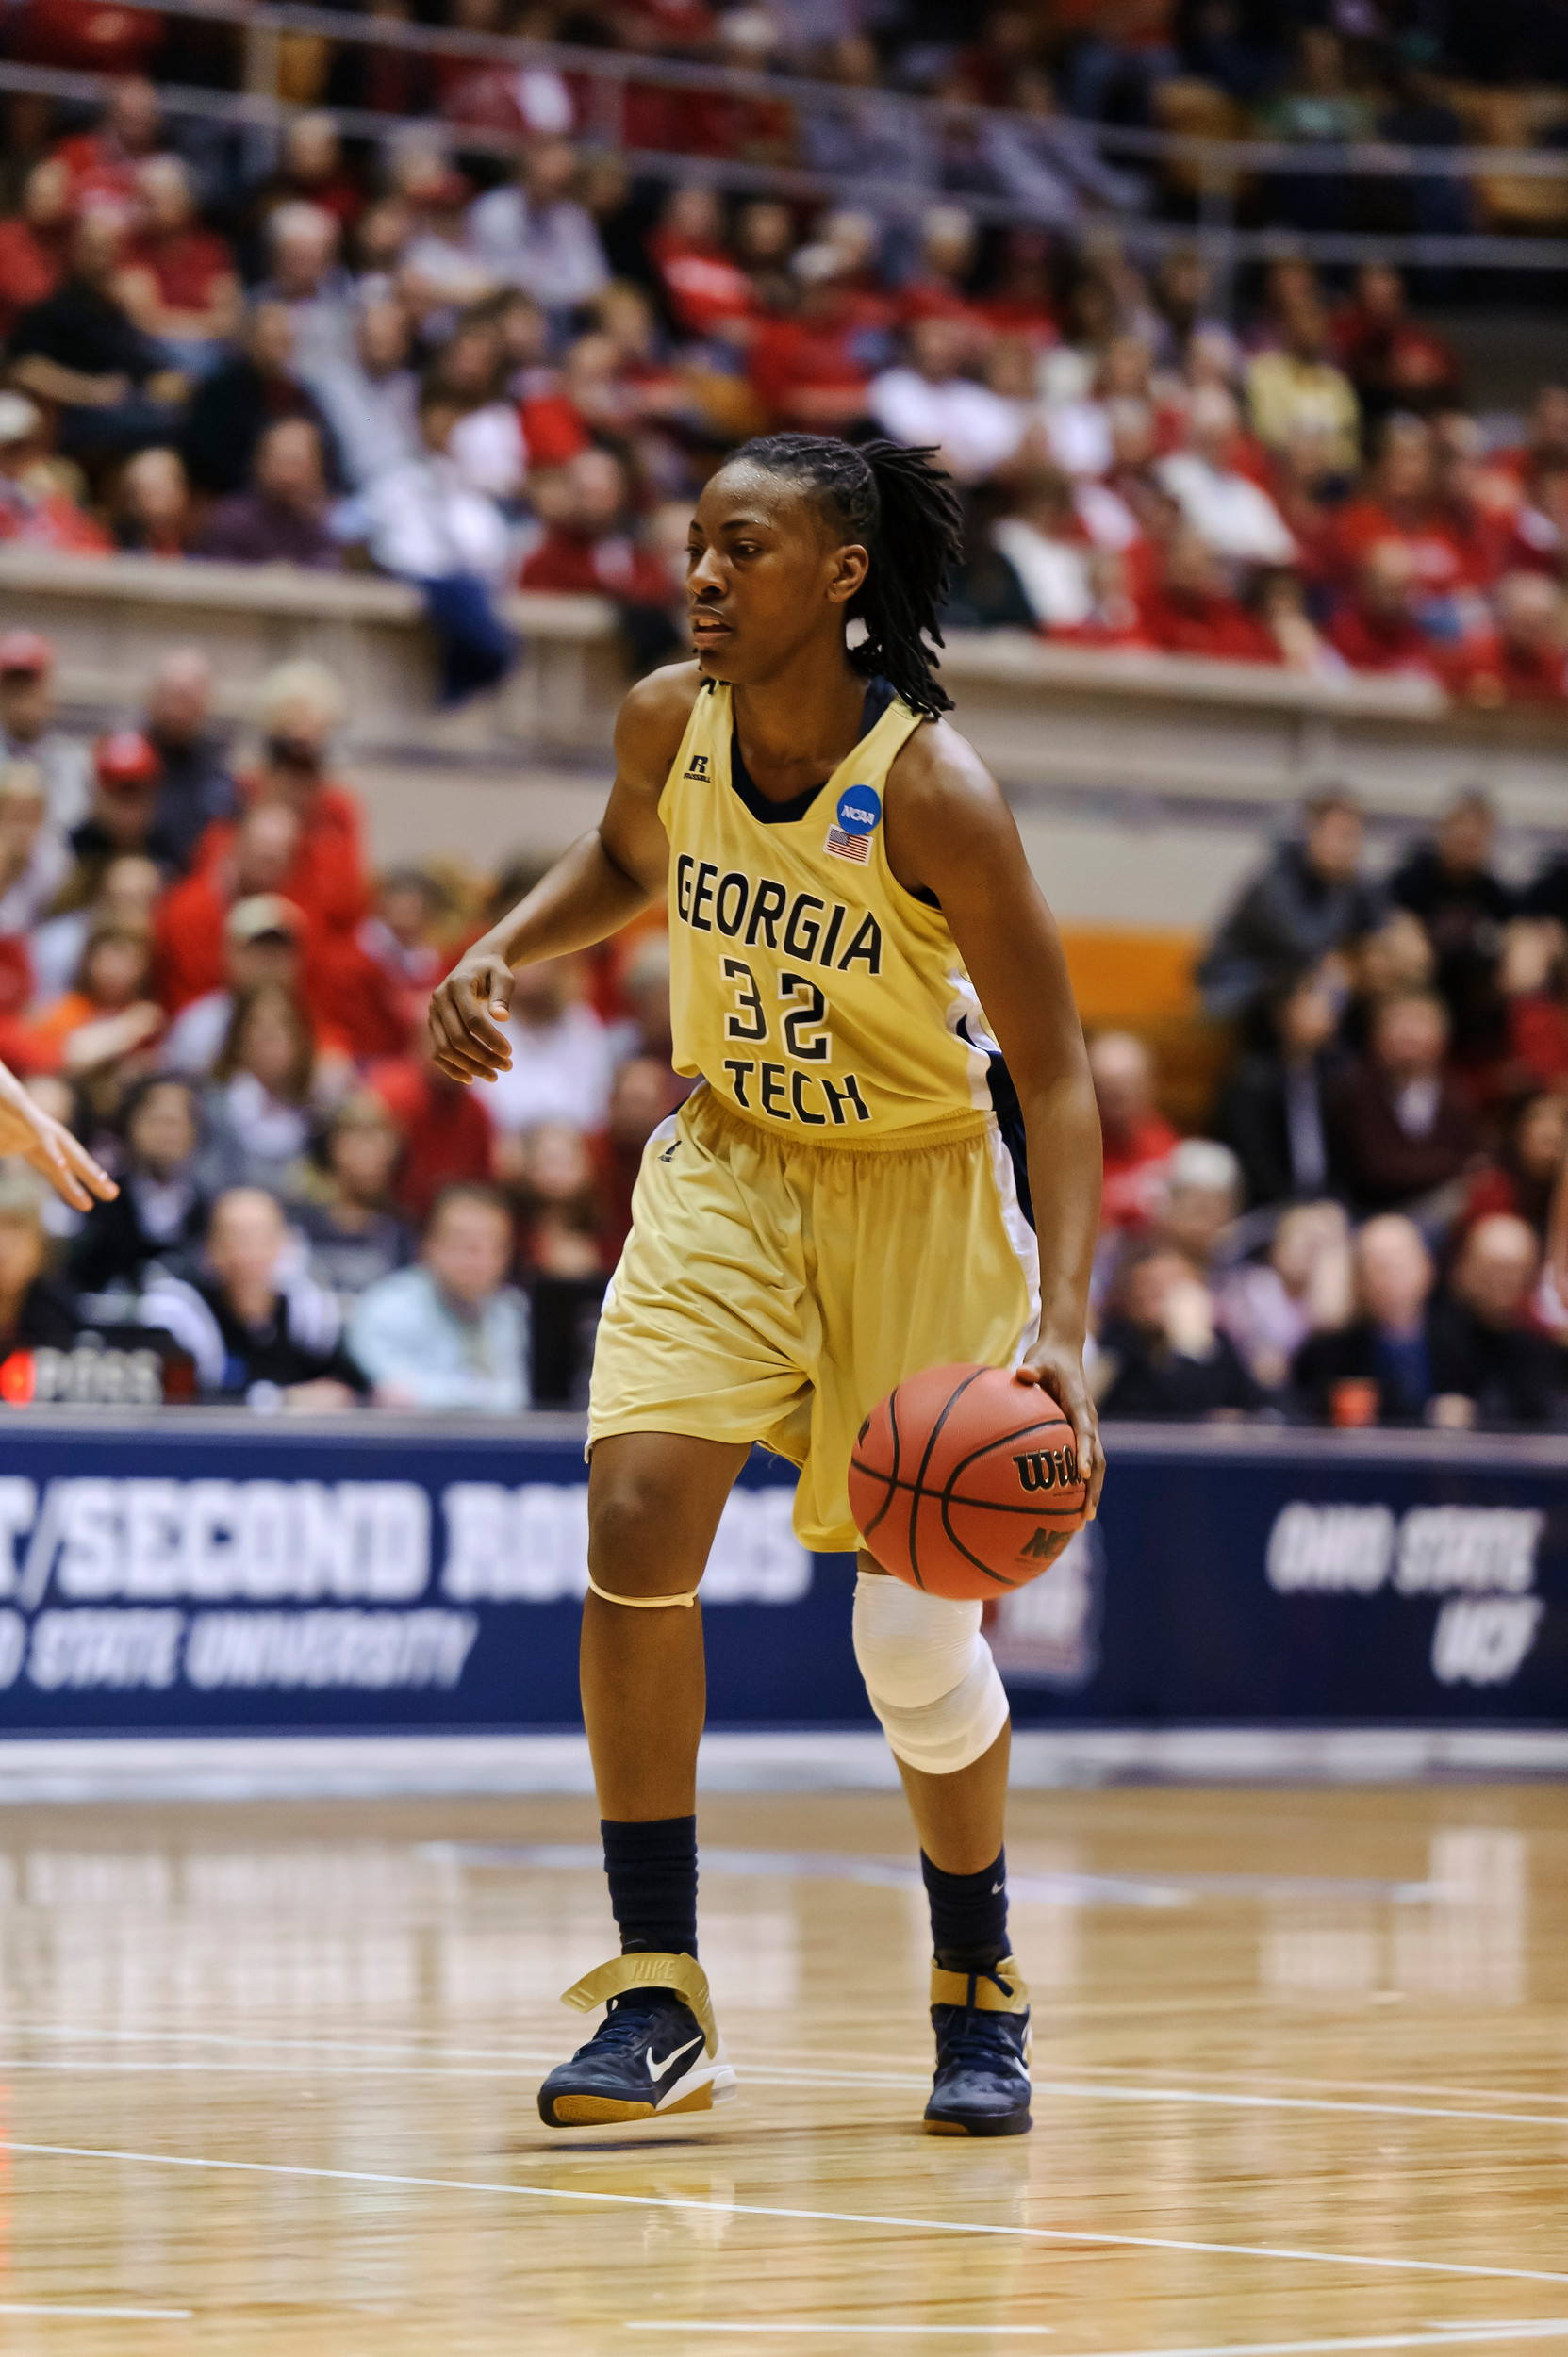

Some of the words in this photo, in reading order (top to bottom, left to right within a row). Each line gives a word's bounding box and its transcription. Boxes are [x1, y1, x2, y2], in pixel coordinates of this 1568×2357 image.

[840, 804, 875, 825] NCAA
[677, 853, 883, 976] GEORGIA
[720, 955, 831, 1063] 32
[723, 1059, 871, 1125] TECH
